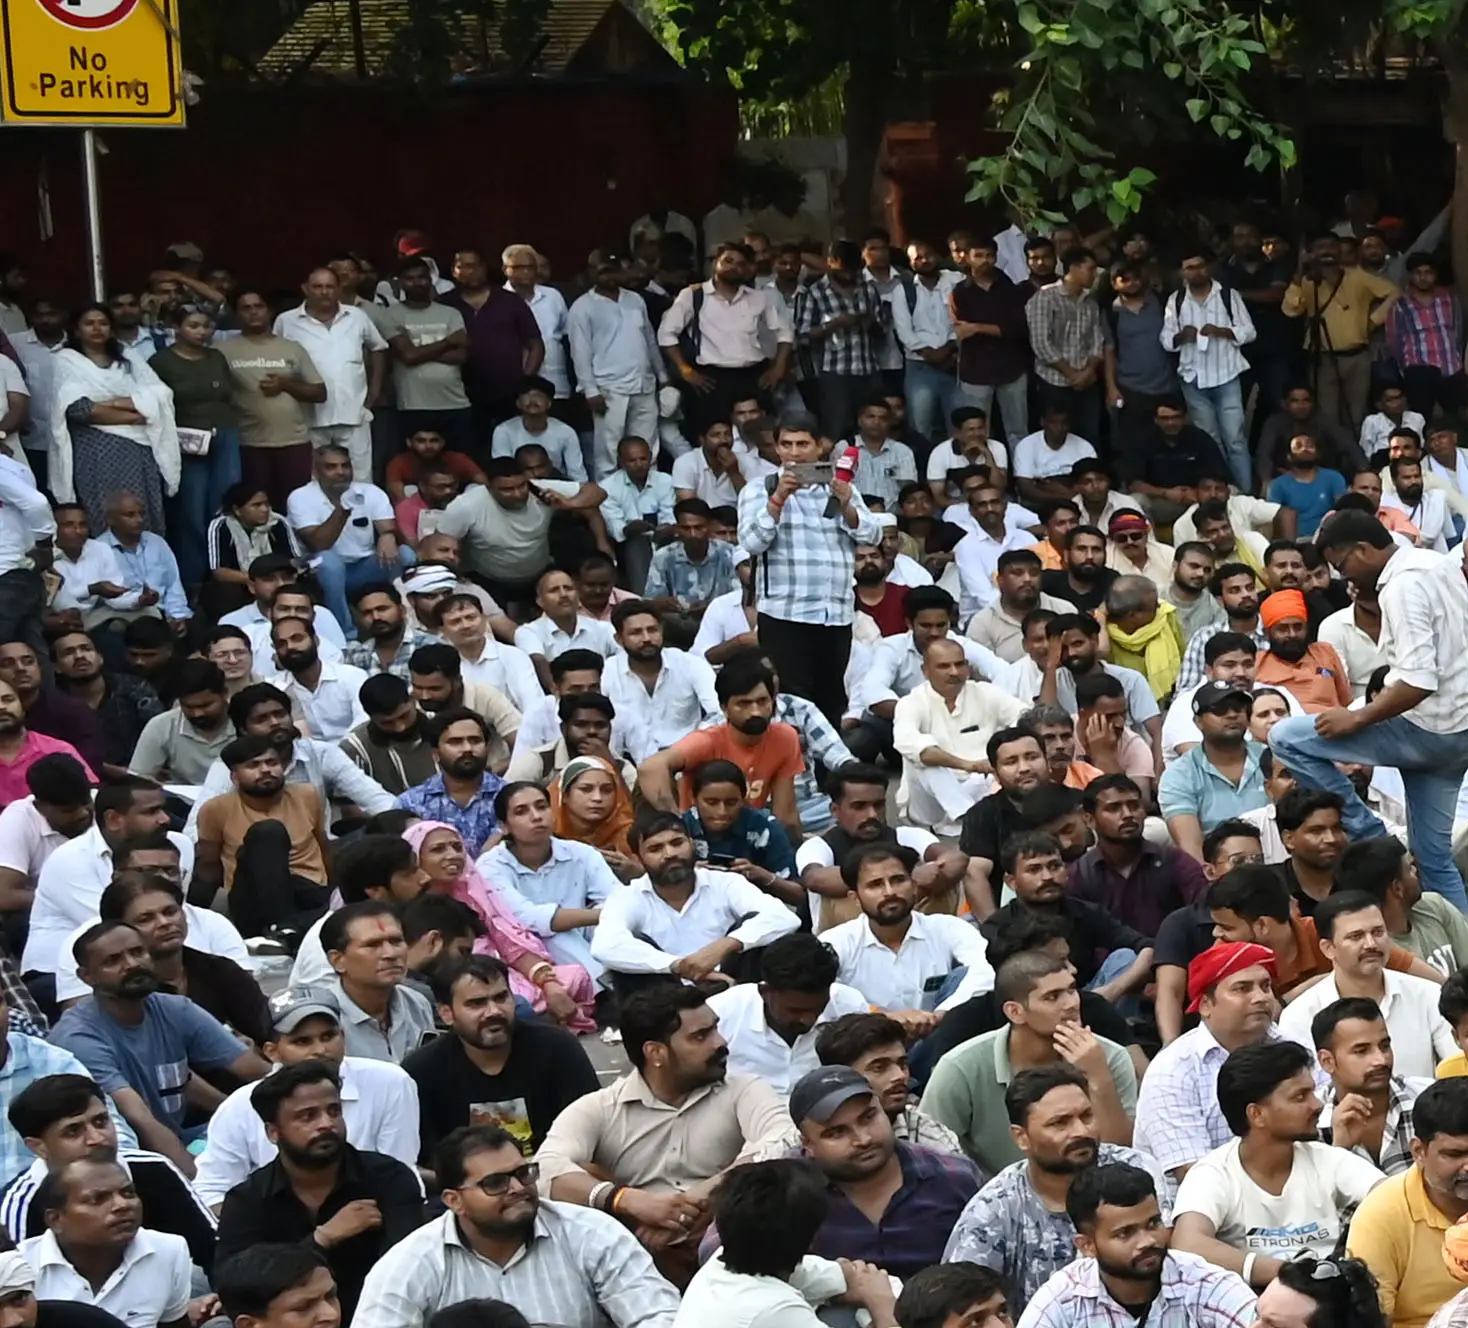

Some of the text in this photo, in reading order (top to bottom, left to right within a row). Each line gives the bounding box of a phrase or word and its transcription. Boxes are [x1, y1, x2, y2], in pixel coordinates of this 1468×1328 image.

[69, 46, 107, 71] No
[39, 72, 149, 106] Parking
[231, 356, 286, 369] Woodland
[1249, 1228, 1330, 1247] ETRONAS
